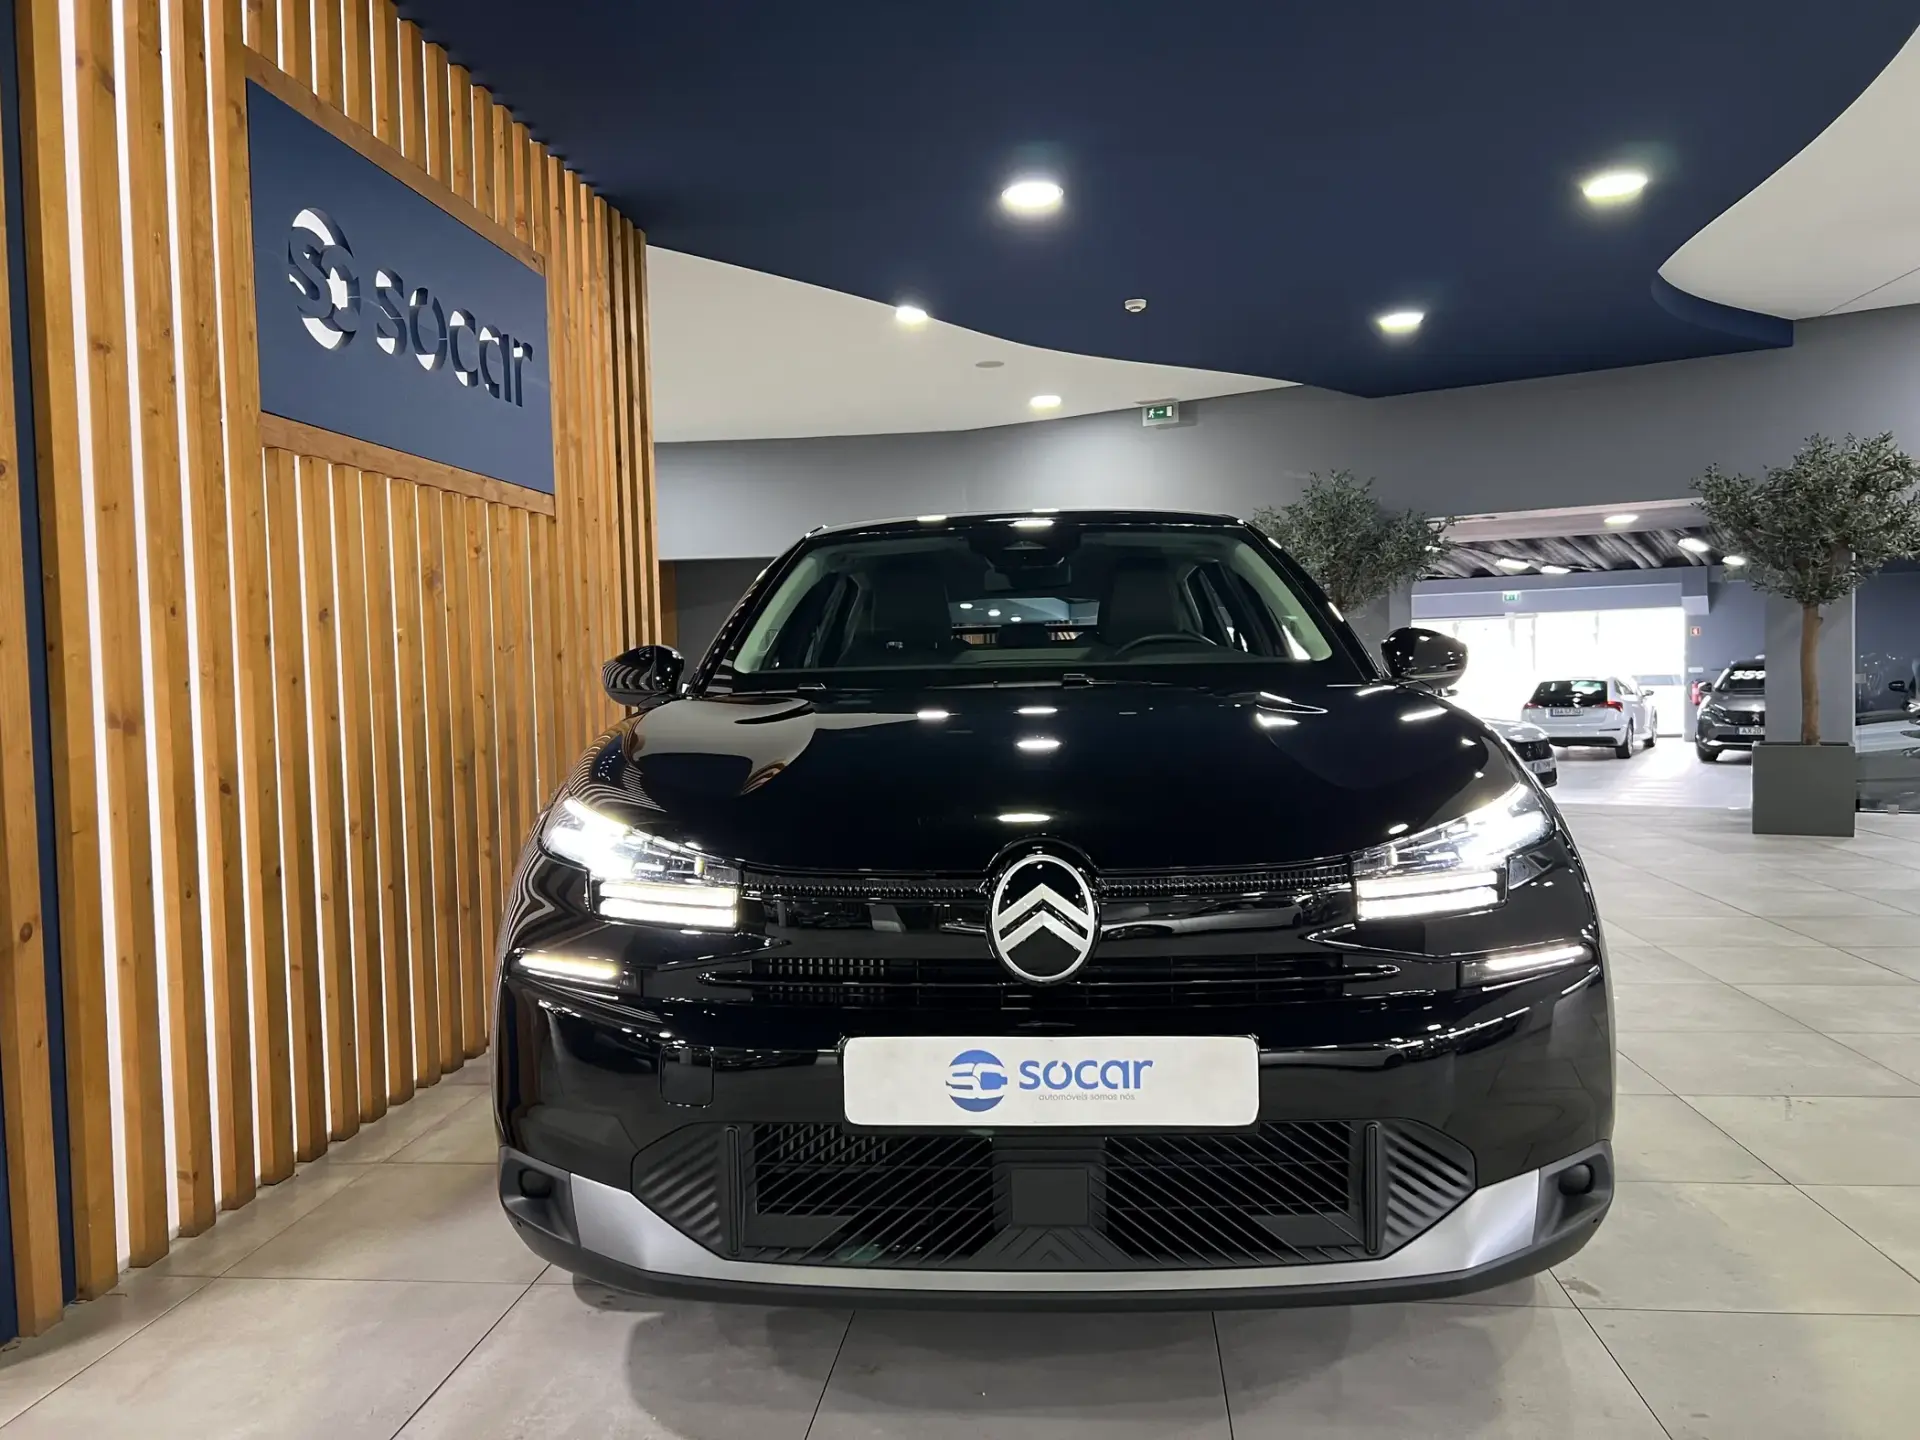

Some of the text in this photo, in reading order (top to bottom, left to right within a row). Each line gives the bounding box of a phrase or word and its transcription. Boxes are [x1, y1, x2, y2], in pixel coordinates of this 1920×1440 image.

[375, 268, 533, 408] socar
[1019, 1059, 1154, 1090] socar
[1038, 1091, 1136, 1101] automóveis somos nós
